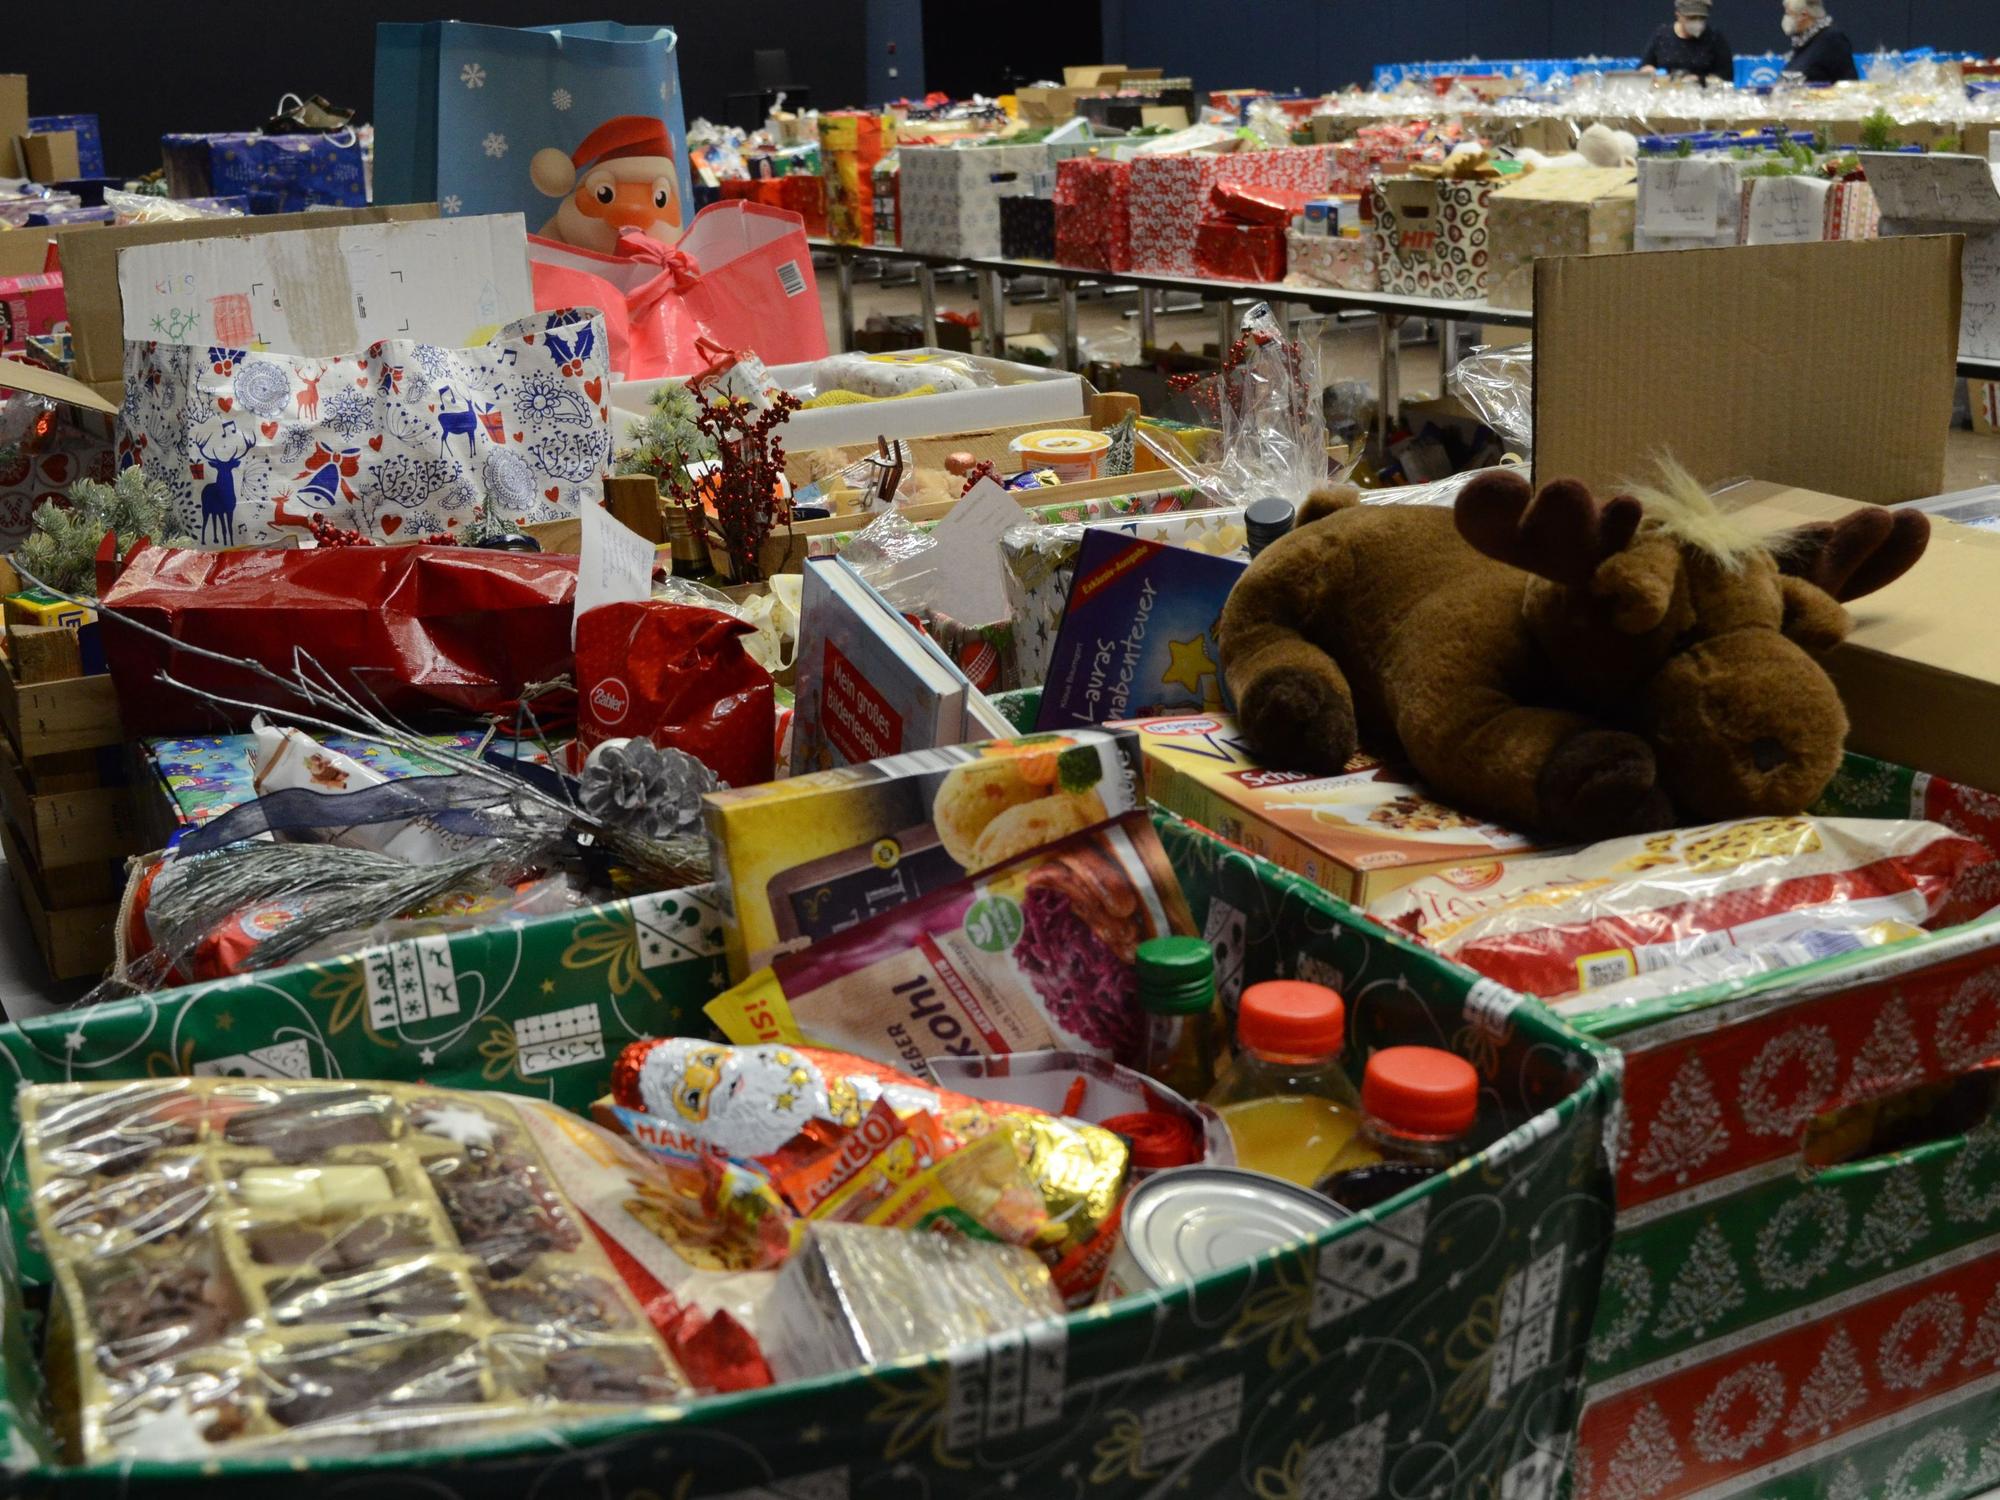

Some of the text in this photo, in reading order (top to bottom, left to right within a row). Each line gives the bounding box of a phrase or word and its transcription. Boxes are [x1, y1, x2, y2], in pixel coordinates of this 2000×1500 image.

[1401, 231, 1437, 249] HIT
[832, 659, 856, 702] Mein
[857, 691, 890, 739] großes
[1071, 638, 1116, 723] Lauras
[827, 686, 890, 759] Bilderlesebu
